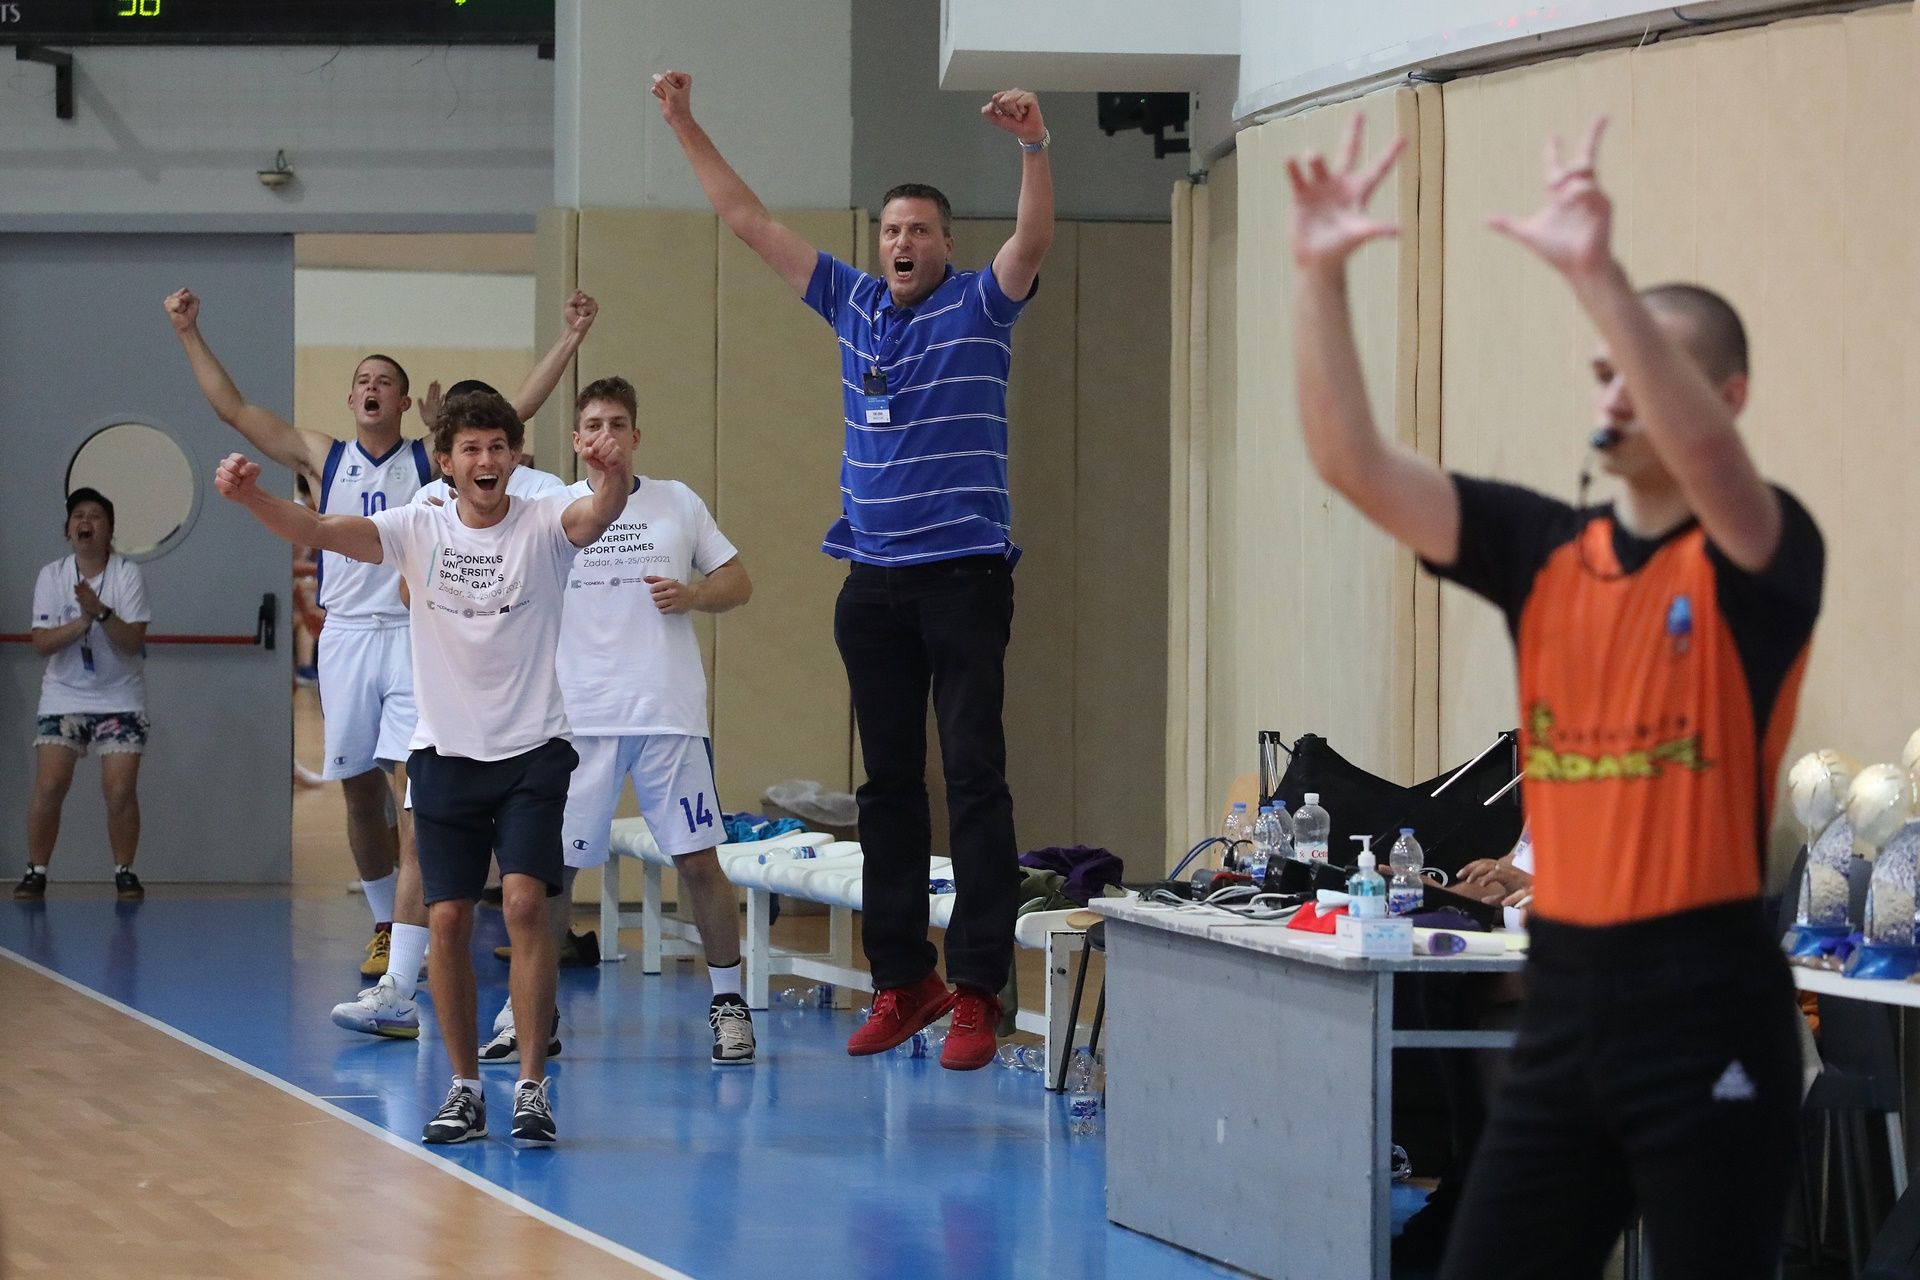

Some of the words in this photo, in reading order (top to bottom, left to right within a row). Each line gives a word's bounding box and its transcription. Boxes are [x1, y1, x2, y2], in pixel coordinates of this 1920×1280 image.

[361, 491, 386, 516] 10
[583, 546, 616, 555] SPORT
[618, 543, 654, 553] GAMES
[442, 559, 496, 577] UNIERSITY
[471, 573, 504, 589] GAMS
[680, 792, 713, 833] 14
